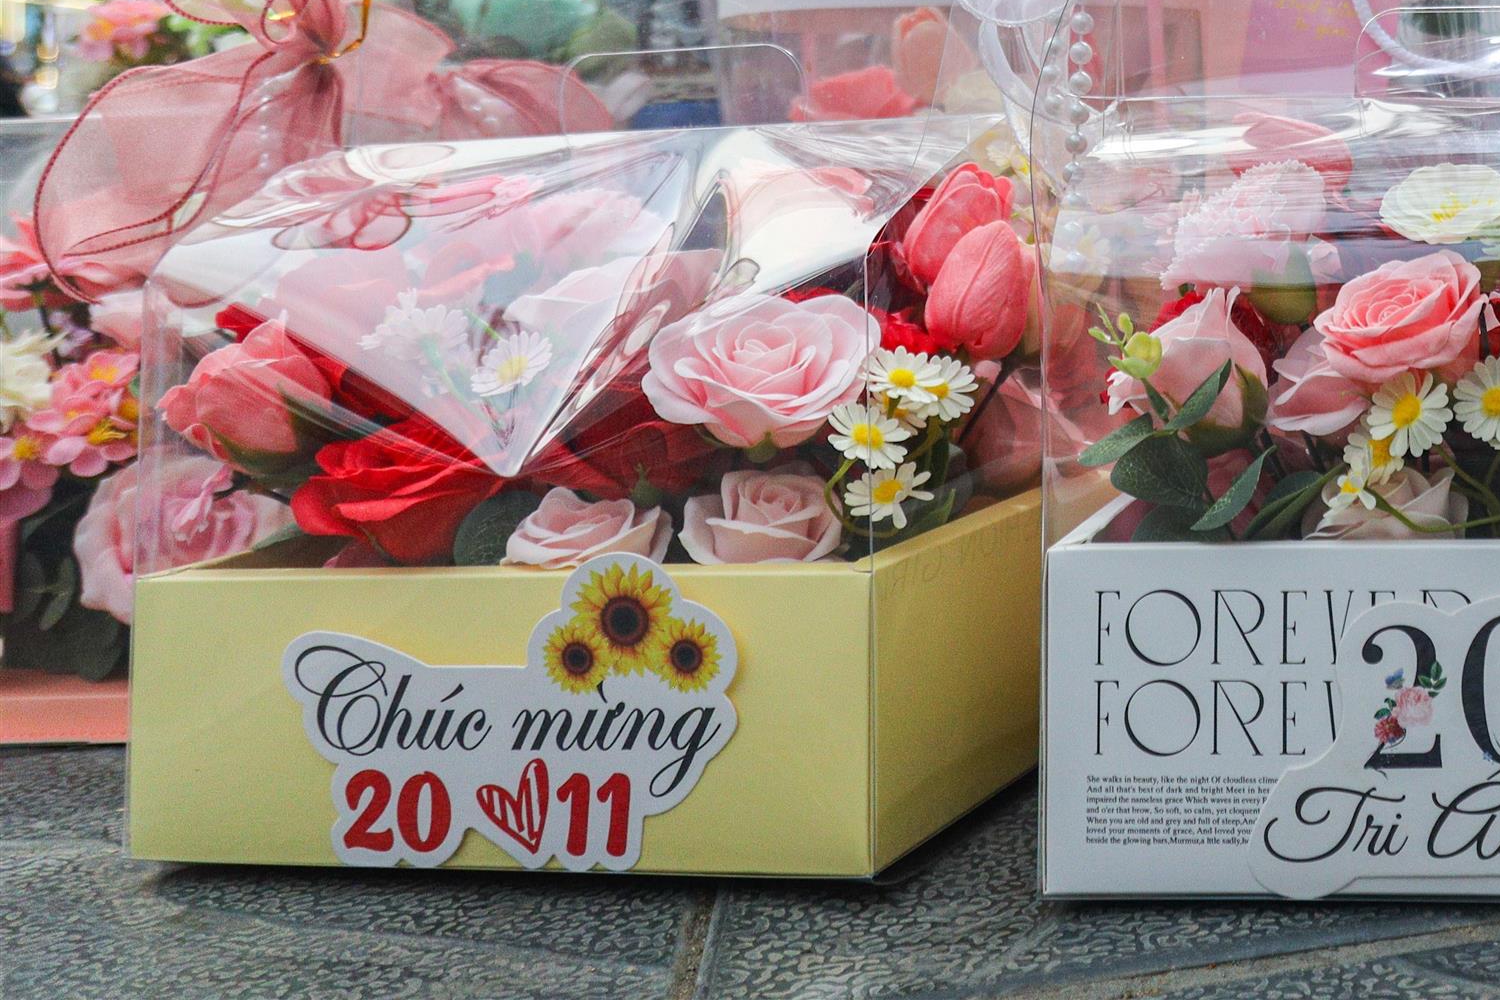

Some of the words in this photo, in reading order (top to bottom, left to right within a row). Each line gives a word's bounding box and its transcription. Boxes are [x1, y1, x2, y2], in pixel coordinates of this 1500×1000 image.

[1095, 589, 1473, 666] FOREV
[294, 645, 491, 756] Chúc
[511, 680, 721, 798] mừng
[1160, 776, 1175, 784] like
[1176, 776, 1188, 784] the
[1190, 776, 1209, 785] night
[1211, 776, 1221, 784] Of
[1166, 786, 1182, 794] dark
[1185, 786, 1199, 794] and
[1200, 786, 1223, 796] bright
[343, 768, 452, 853] 20
[556, 772, 632, 857] 11
[1086, 806, 1100, 814] and
[1216, 807, 1227, 816] yet
[1183, 817, 1197, 825] and
[1264, 785, 1409, 863] Tri
